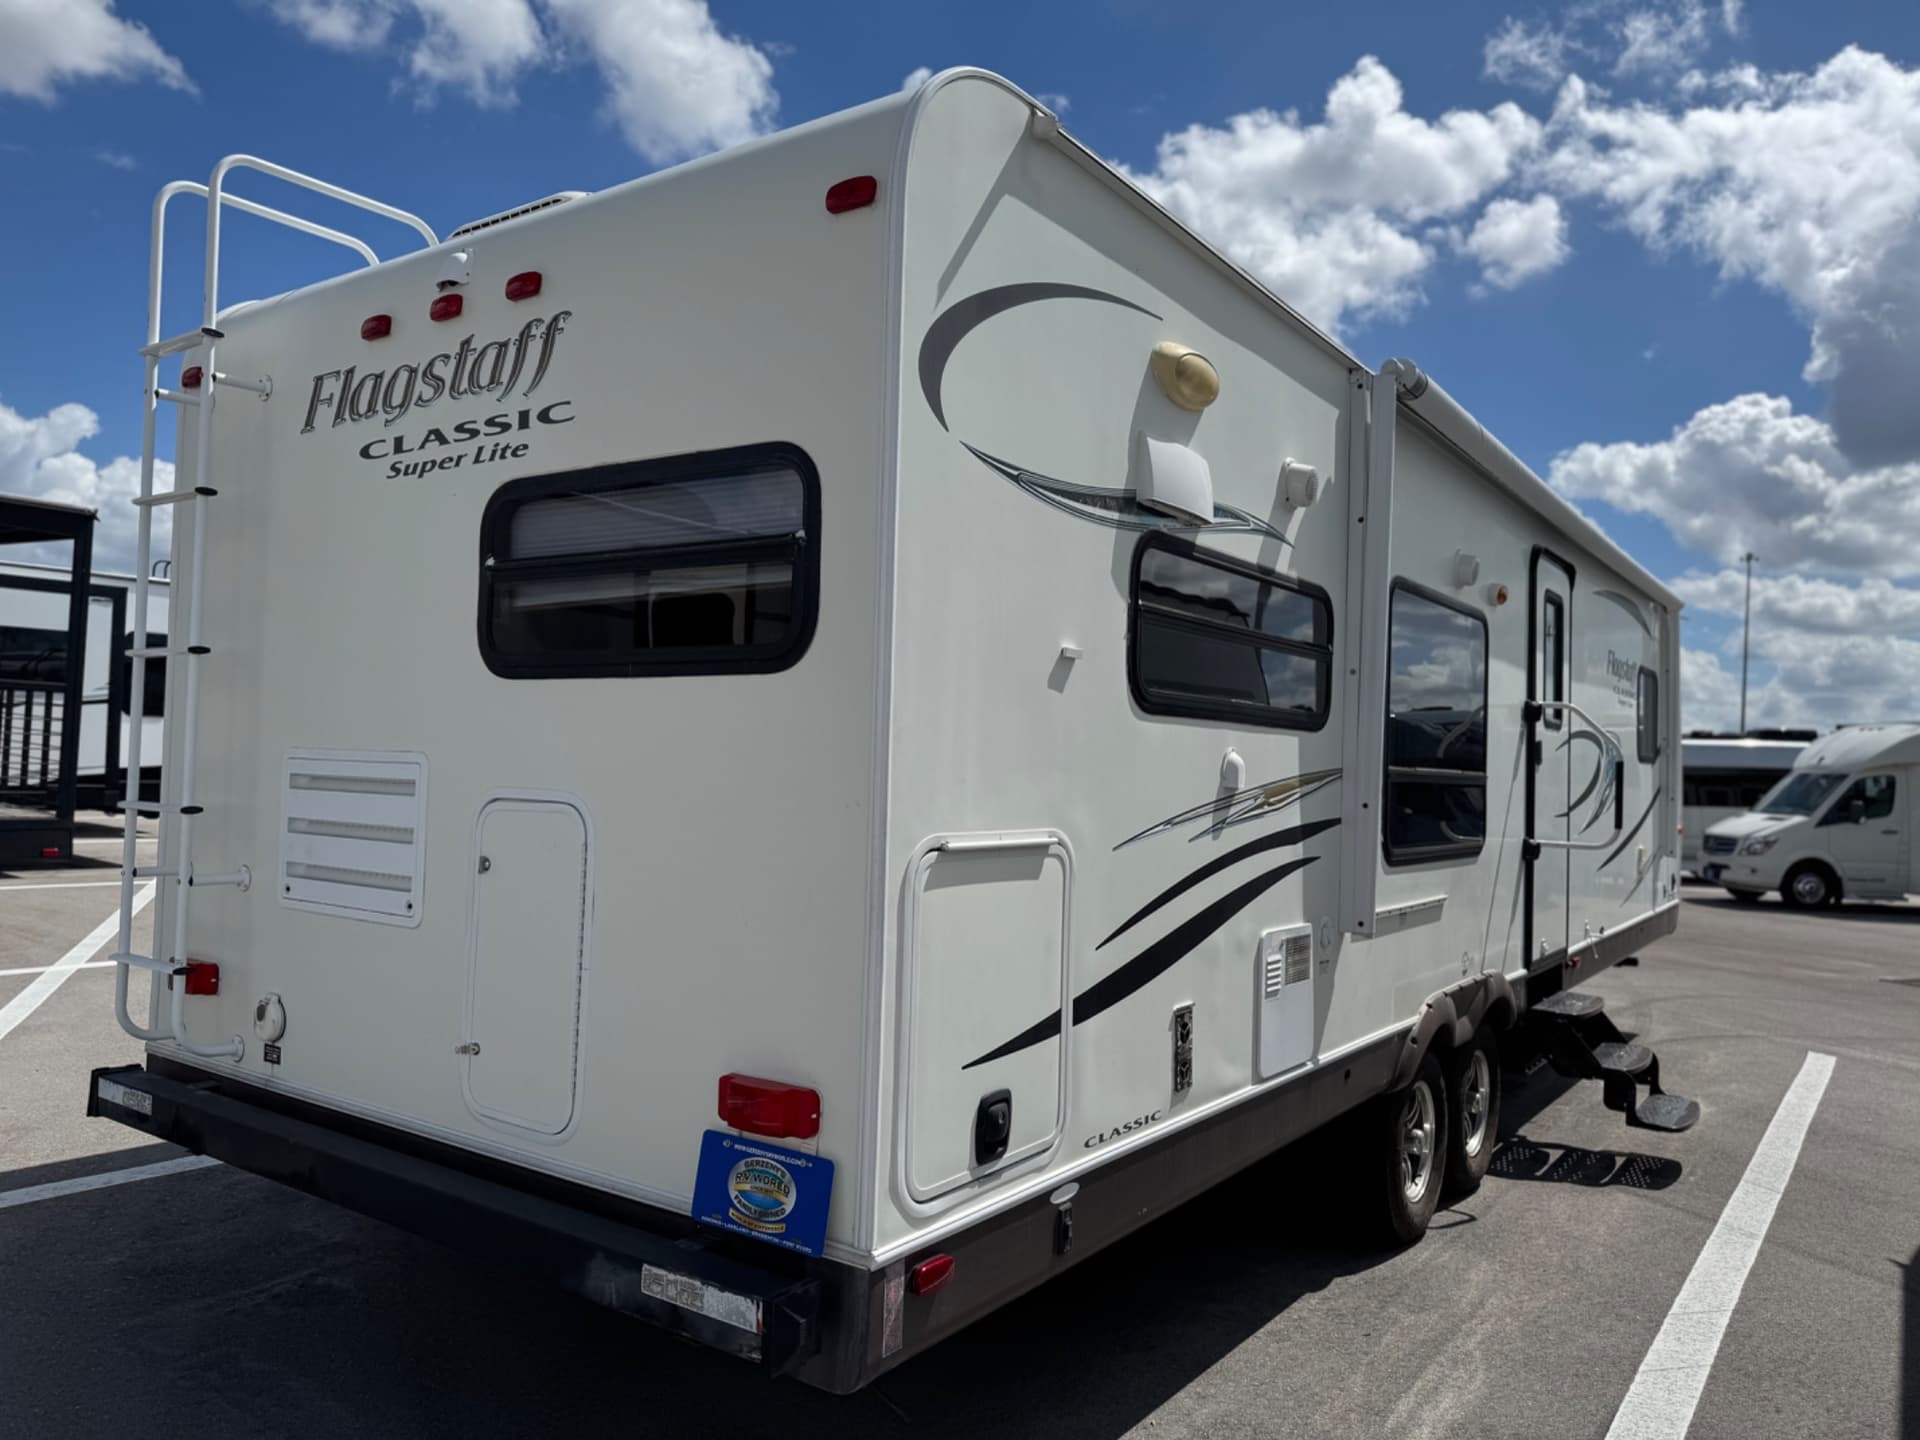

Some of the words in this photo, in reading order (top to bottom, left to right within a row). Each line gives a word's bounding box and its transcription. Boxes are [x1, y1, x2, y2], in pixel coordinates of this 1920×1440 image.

[300, 310, 573, 434] Flagstaff
[359, 401, 576, 460] CLASSIC
[386, 453, 467, 479] Super
[472, 443, 529, 465] Lite
[1083, 1110, 1163, 1148] CLASSIC
[753, 1173, 790, 1196] WORLD
